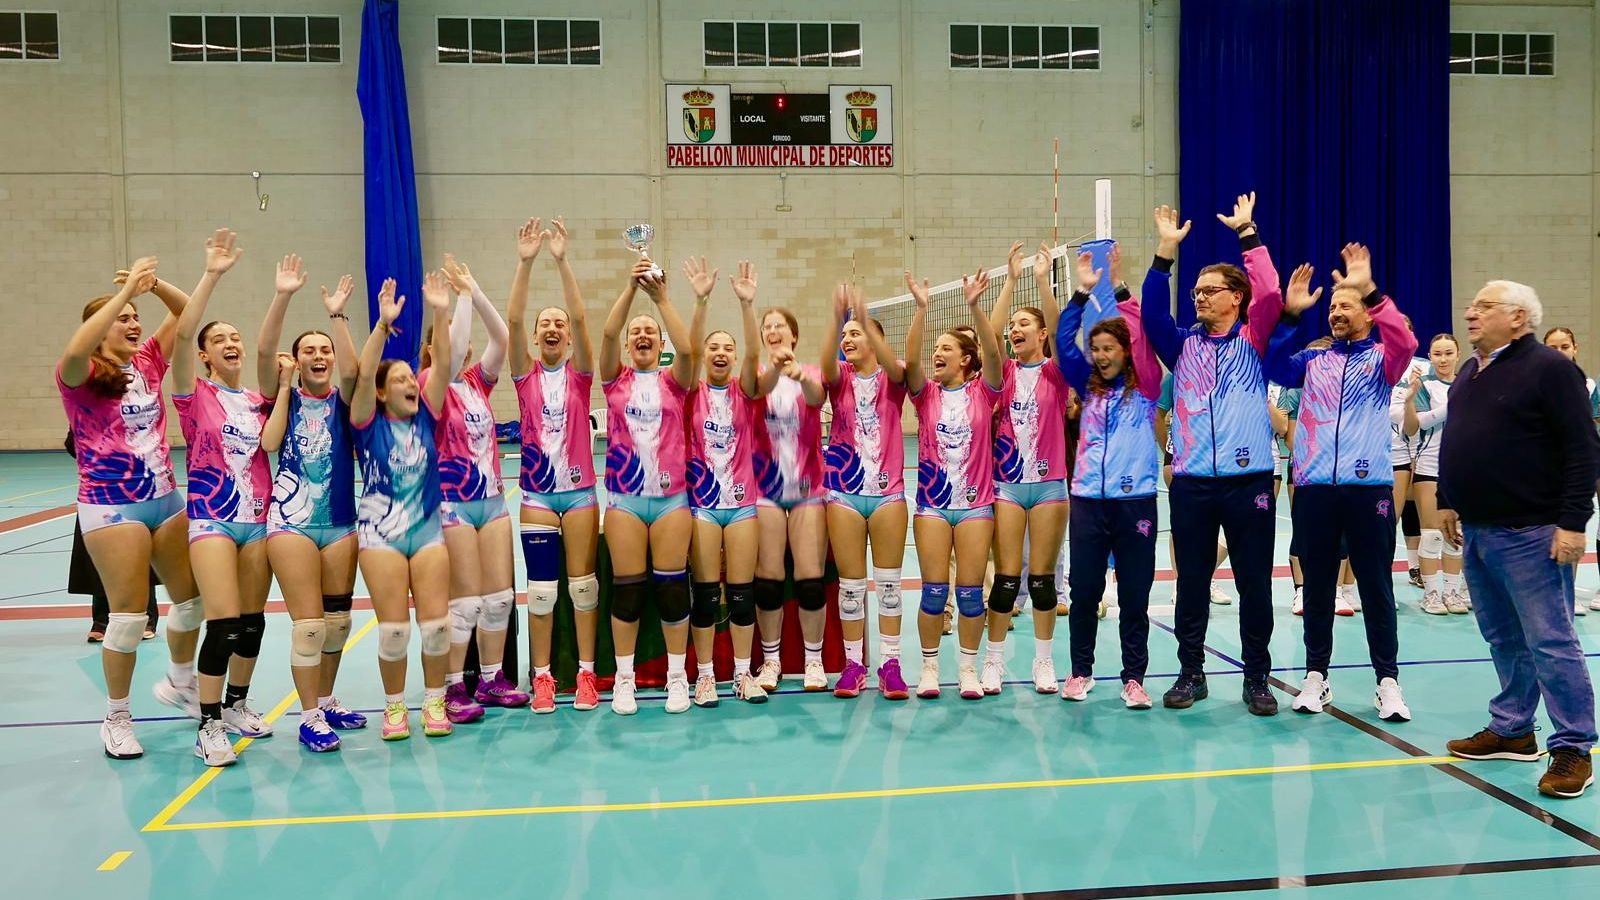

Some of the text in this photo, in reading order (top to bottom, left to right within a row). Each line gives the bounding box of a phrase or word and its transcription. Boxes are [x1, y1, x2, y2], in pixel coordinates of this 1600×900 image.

[739, 115, 766, 123] LOCAL
[800, 115, 826, 123] VISITANTE
[668, 145, 892, 166] PABELLON MUNICIPAL DE DEPORTES
[1235, 447, 1250, 458] 25
[1037, 460, 1048, 469] 25
[1355, 459, 1369, 469] 25
[569, 466, 580, 475] 25
[878, 473, 888, 481] 25
[1120, 476, 1133, 485] 25
[733, 485, 744, 493] 25
